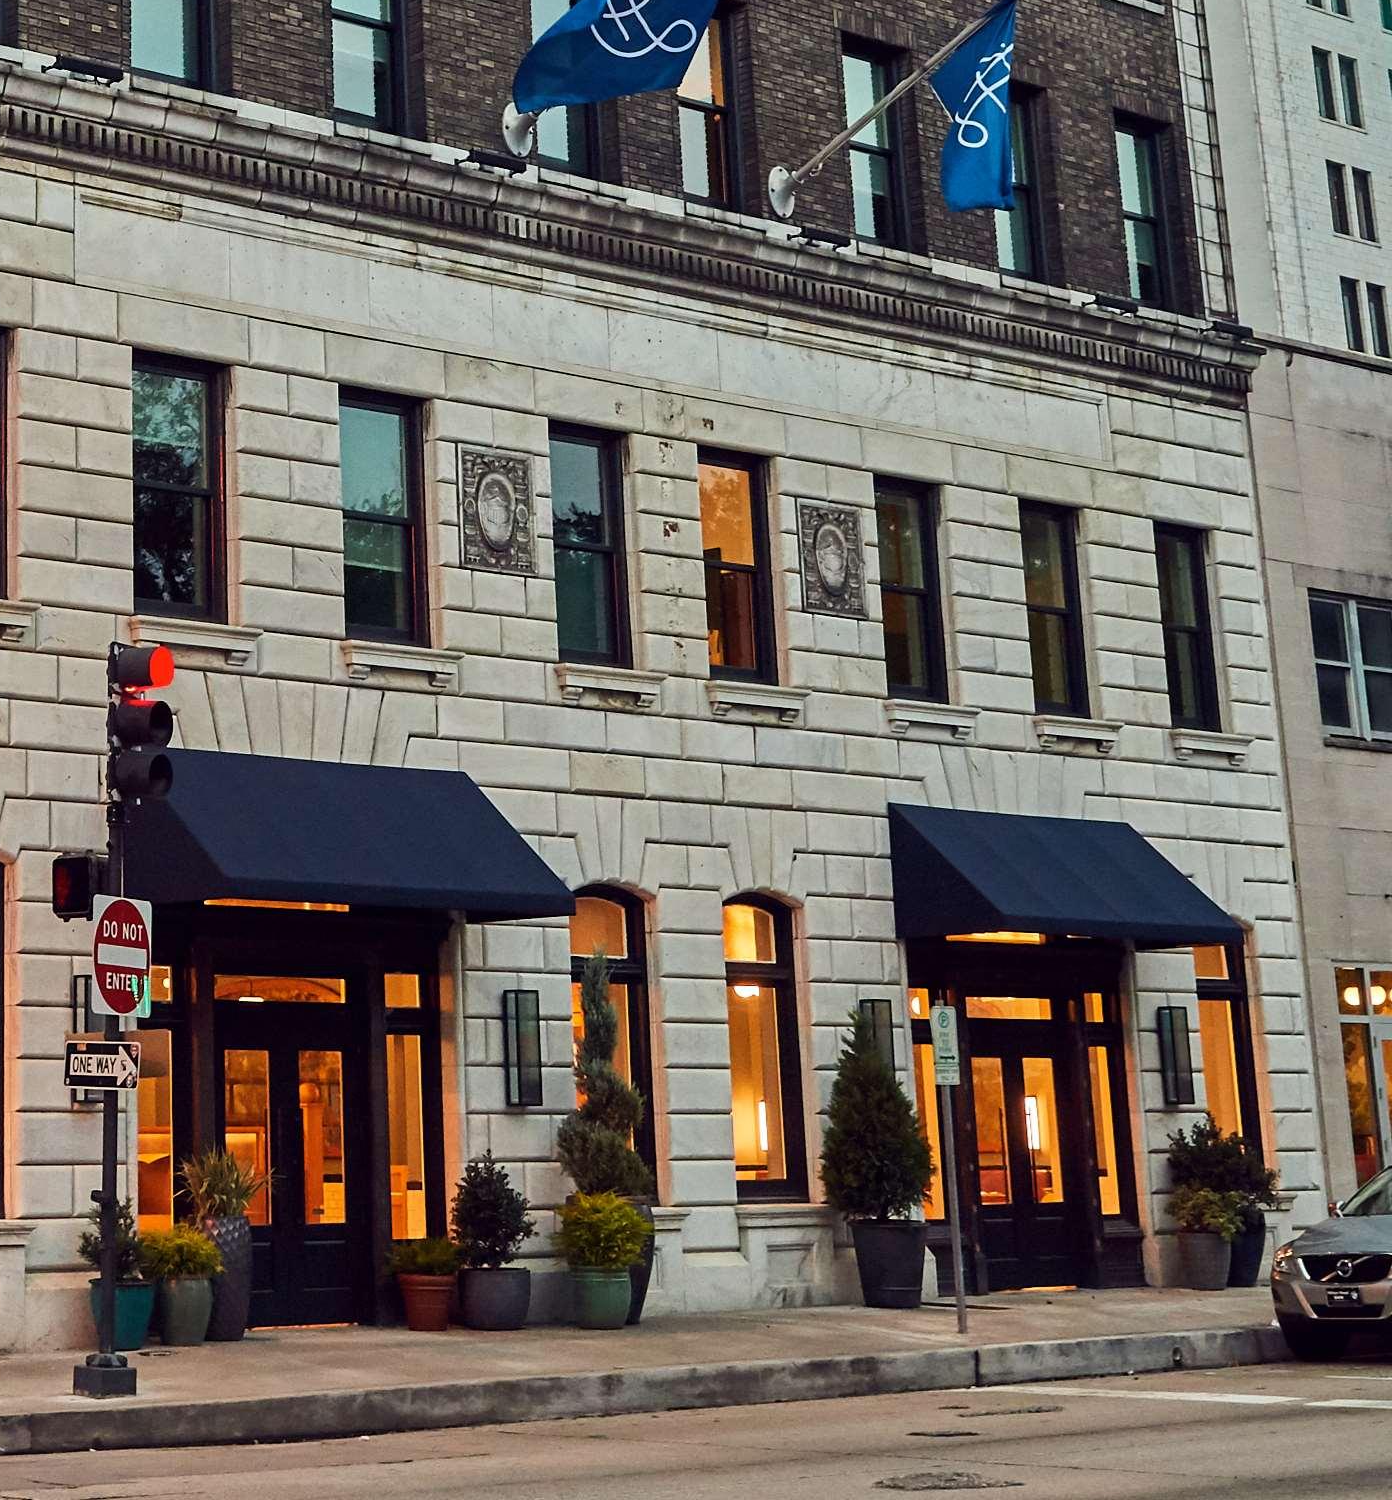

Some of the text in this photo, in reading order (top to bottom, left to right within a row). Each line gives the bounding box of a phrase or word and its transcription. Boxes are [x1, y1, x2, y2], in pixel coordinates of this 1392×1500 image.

[103, 920, 143, 942] DO NOT
[72, 1056, 117, 1074] ONE WAY
